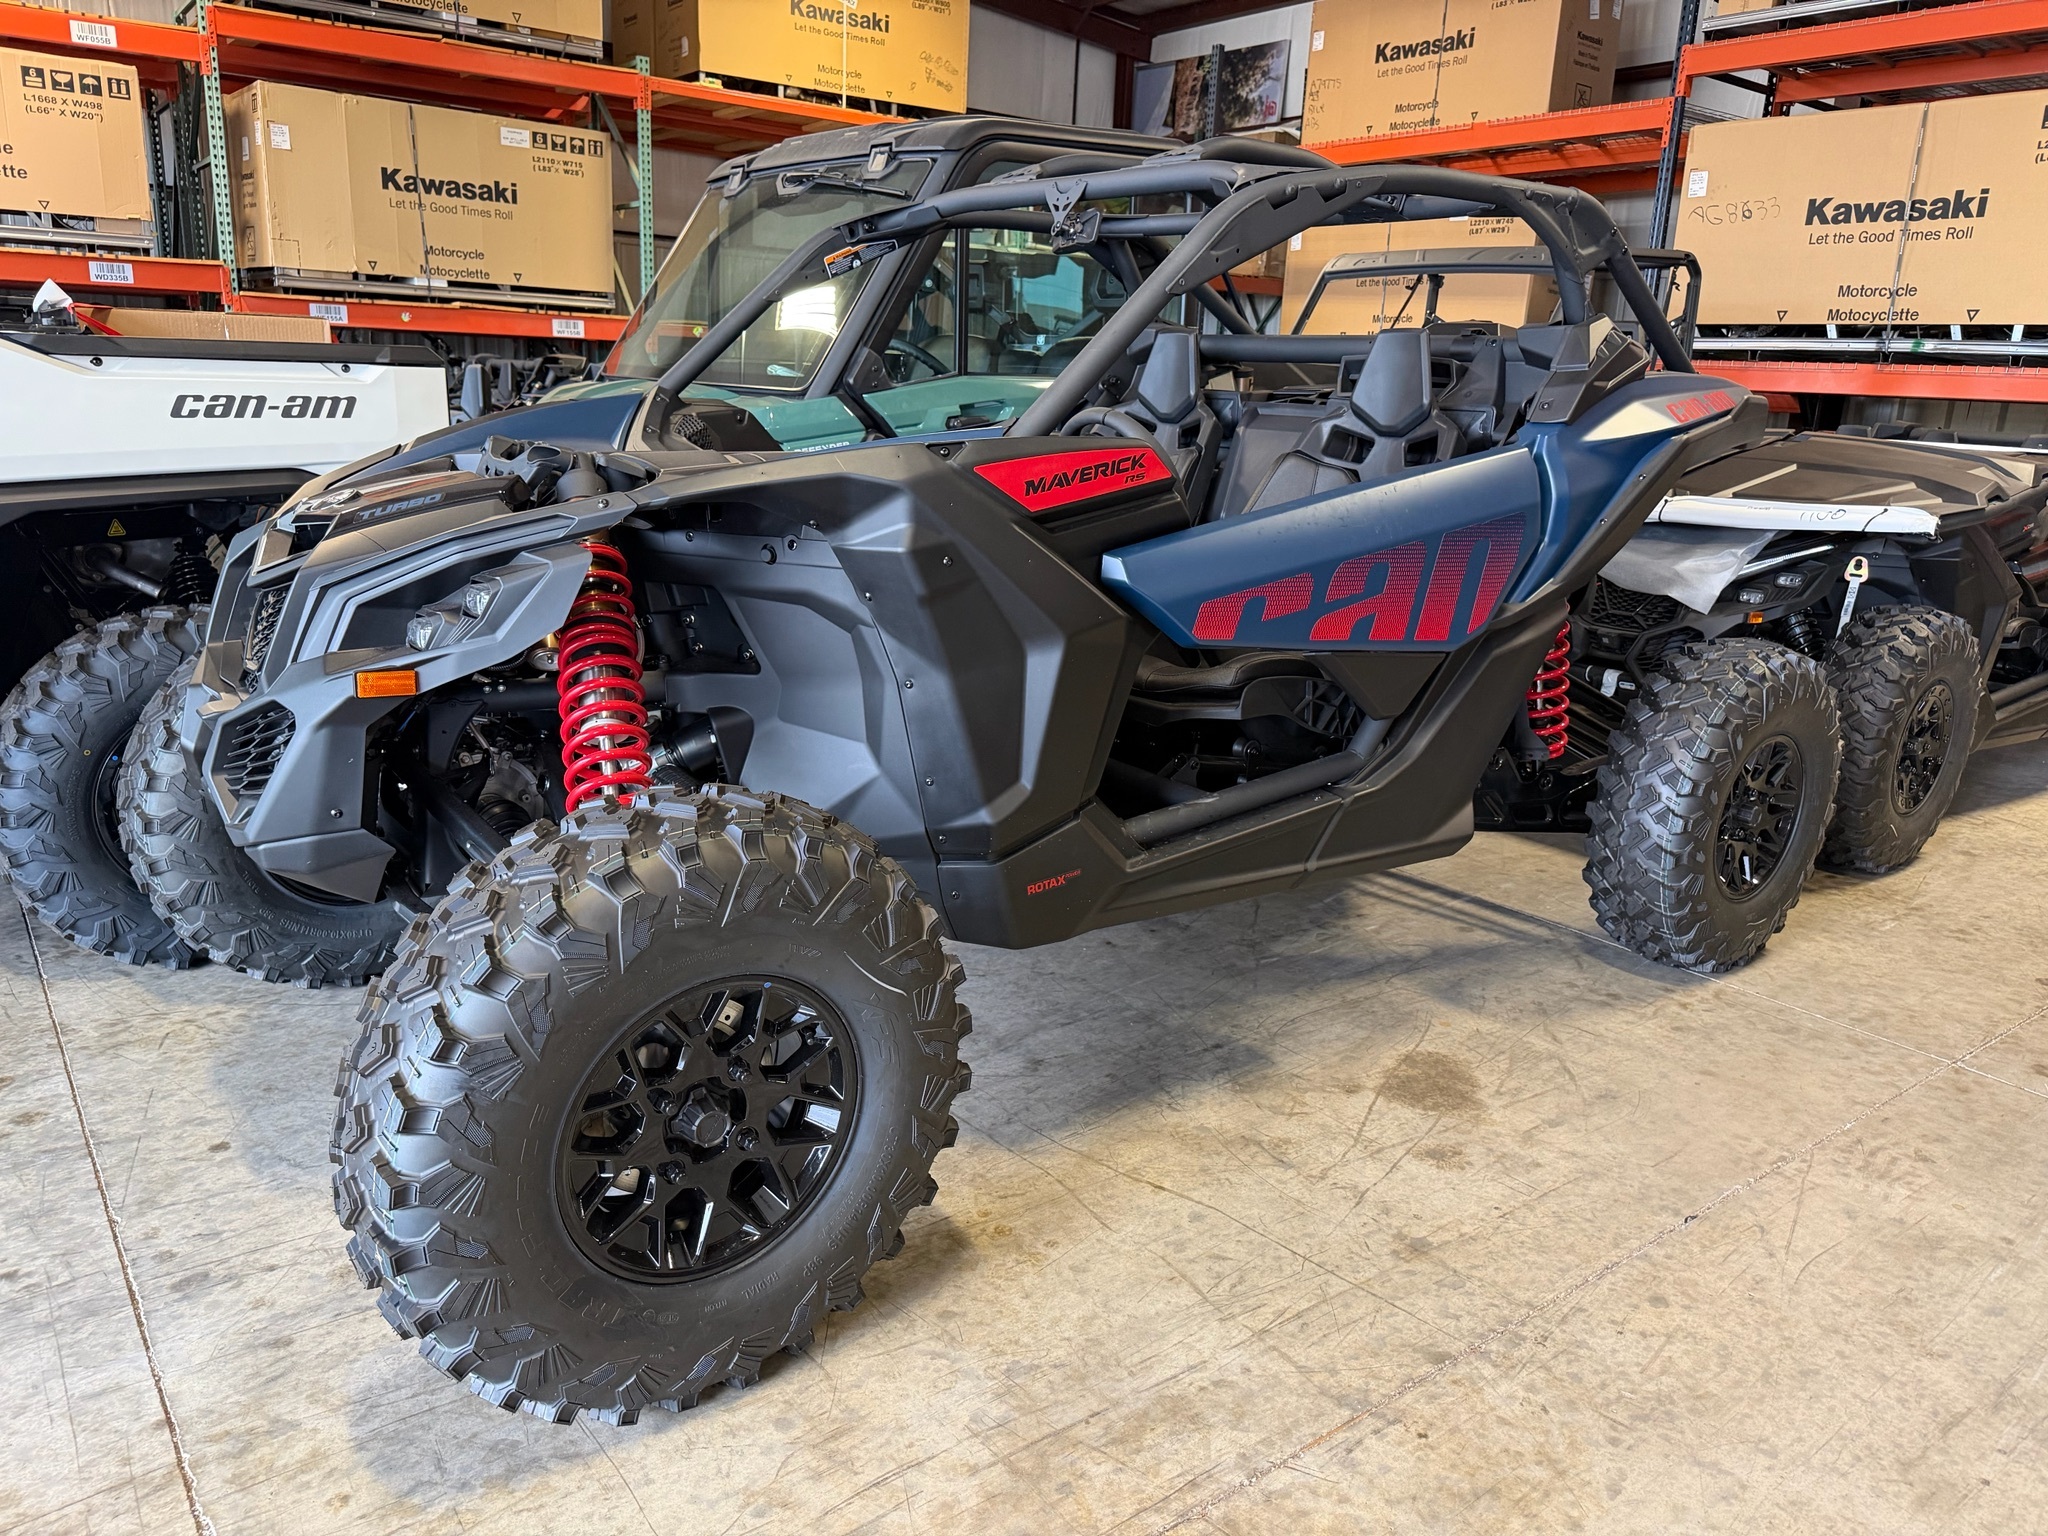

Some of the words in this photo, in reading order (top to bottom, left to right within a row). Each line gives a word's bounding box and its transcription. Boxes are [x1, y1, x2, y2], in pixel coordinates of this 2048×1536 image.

[790, 0, 890, 33] Kawasaki
[76, 33, 112, 45] WF055B
[794, 22, 807, 32] Let
[809, 25, 821, 35] the
[823, 28, 844, 39] Good
[846, 32, 869, 43] Times
[870, 37, 886, 47] Roll
[1374, 26, 1477, 64] Kawasaki
[817, 64, 862, 80] Motorcycle
[1377, 68, 1390, 79] Let
[1391, 66, 1404, 77] the
[1405, 62, 1426, 73] Good
[1452, 54, 1468, 66] Roll
[814, 78, 866, 94] Motocyclette
[24, 93, 57, 105] L1668
[72, 98, 103, 111] W498
[1394, 99, 1439, 114] Motorcycle
[59, 109, 67, 117] X
[1388, 117, 1441, 132] Motocyclette
[380, 166, 518, 205] Kawasaki
[389, 198, 407, 210] Let
[409, 200, 427, 212] the
[430, 202, 458, 215] Good
[460, 205, 492, 219] Times
[494, 209, 513, 221] Roll
[1804, 187, 1991, 226] Kawasaki
[1808, 233, 1829, 245] Let
[1833, 231, 1855, 244] the
[1858, 229, 1895, 243] Good
[1945, 226, 1974, 240] Roll
[425, 245, 485, 260] Motorcycle
[94, 273, 129, 282] WD335B
[419, 264, 490, 280] Motocyclette
[1356, 279, 1366, 288] Let
[1368, 278, 1380, 287] the
[1382, 277, 1400, 286] Good
[1837, 283, 1918, 300] Motorcycle
[1826, 308, 1920, 323] Motocyclette
[169, 394, 358, 420] can-am
[1024, 452, 1147, 498] MAVERICK
[1125, 472, 1147, 483] RS
[359, 493, 442, 521] TURBO
[1027, 874, 1067, 896] ROTAX
